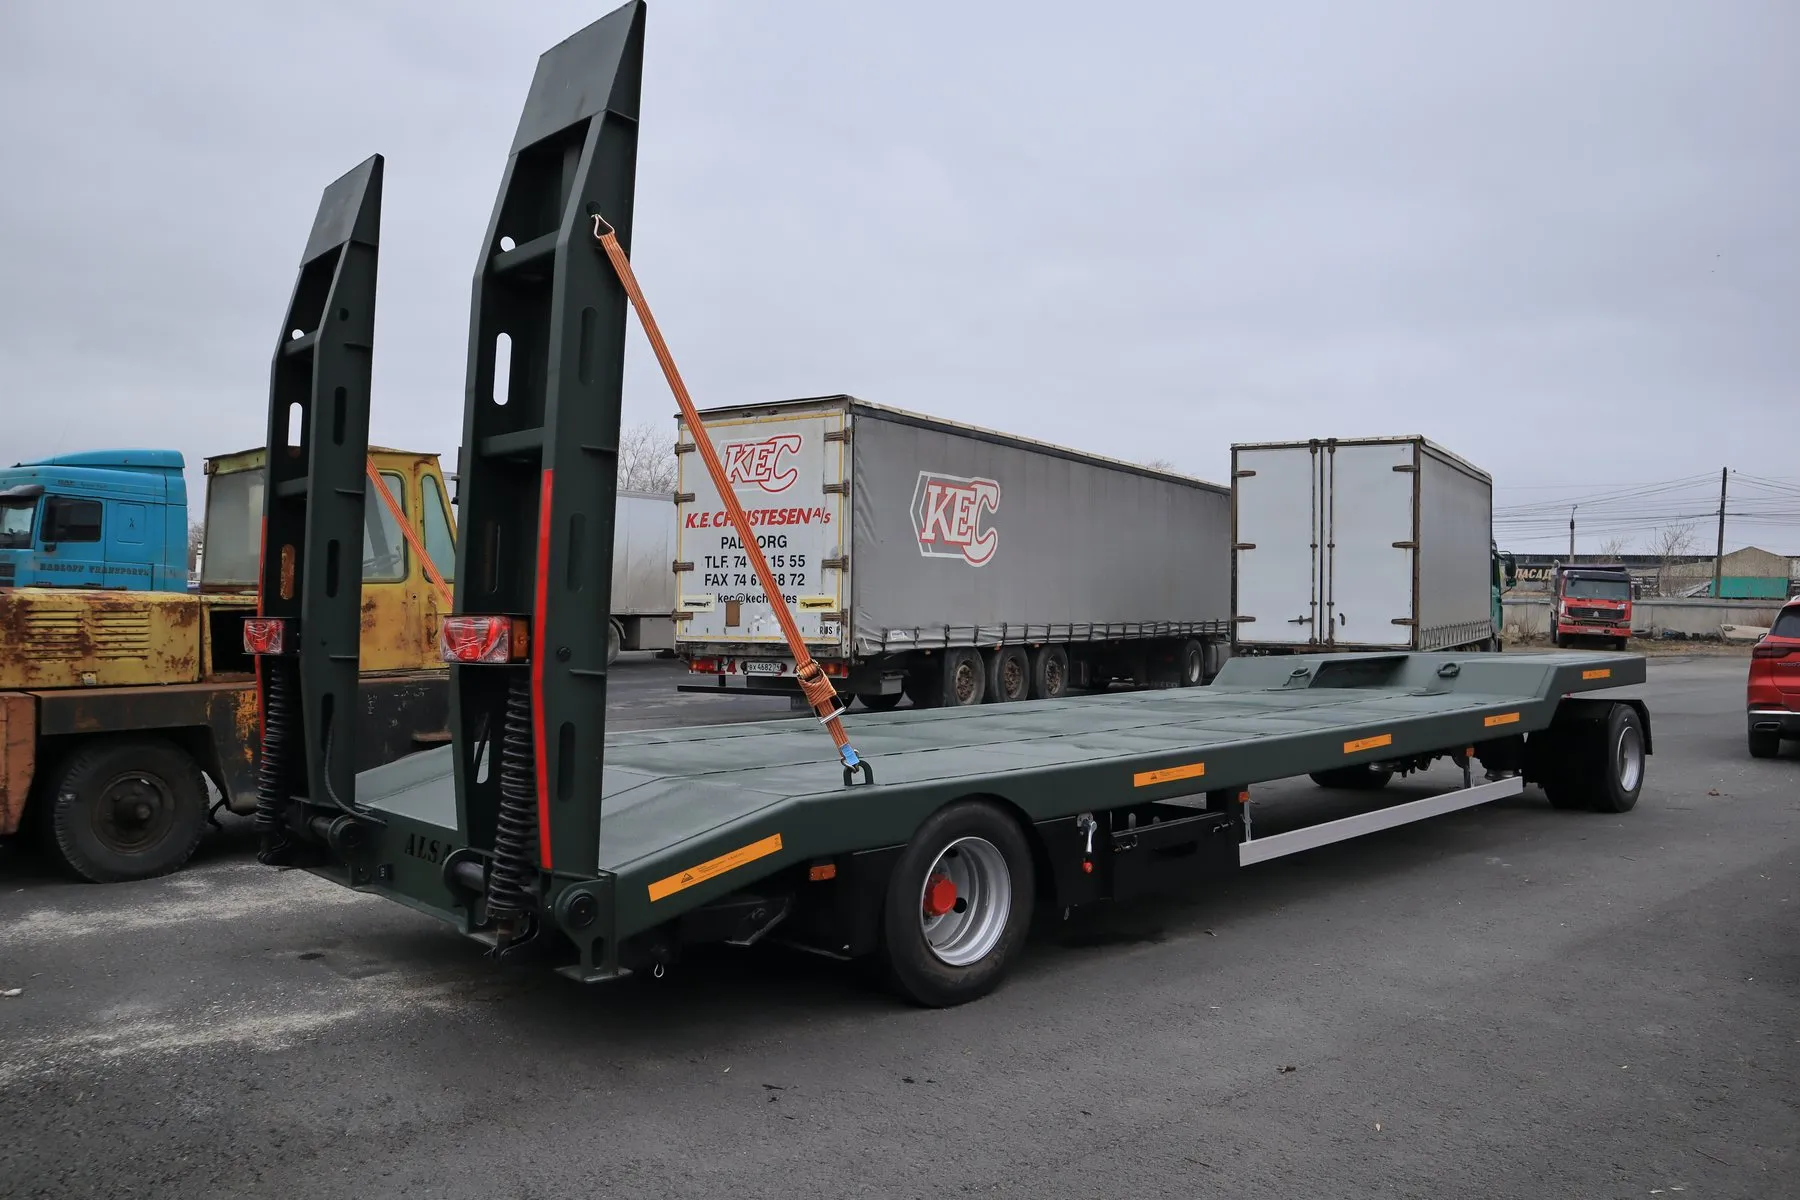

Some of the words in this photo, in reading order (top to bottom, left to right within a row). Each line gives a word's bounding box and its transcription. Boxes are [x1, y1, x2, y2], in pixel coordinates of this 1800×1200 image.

[725, 435, 802, 492] KEC
[920, 479, 999, 565] KEC
[721, 535, 787, 549] PAORG
[705, 556, 728, 568] TLF.
[734, 556, 746, 568] 74
[771, 555, 784, 567] 15
[789, 554, 805, 567] 55
[705, 574, 728, 586] FAX
[734, 574, 746, 586] 74
[790, 573, 805, 585] 72
[819, 626, 833, 635] RUS
